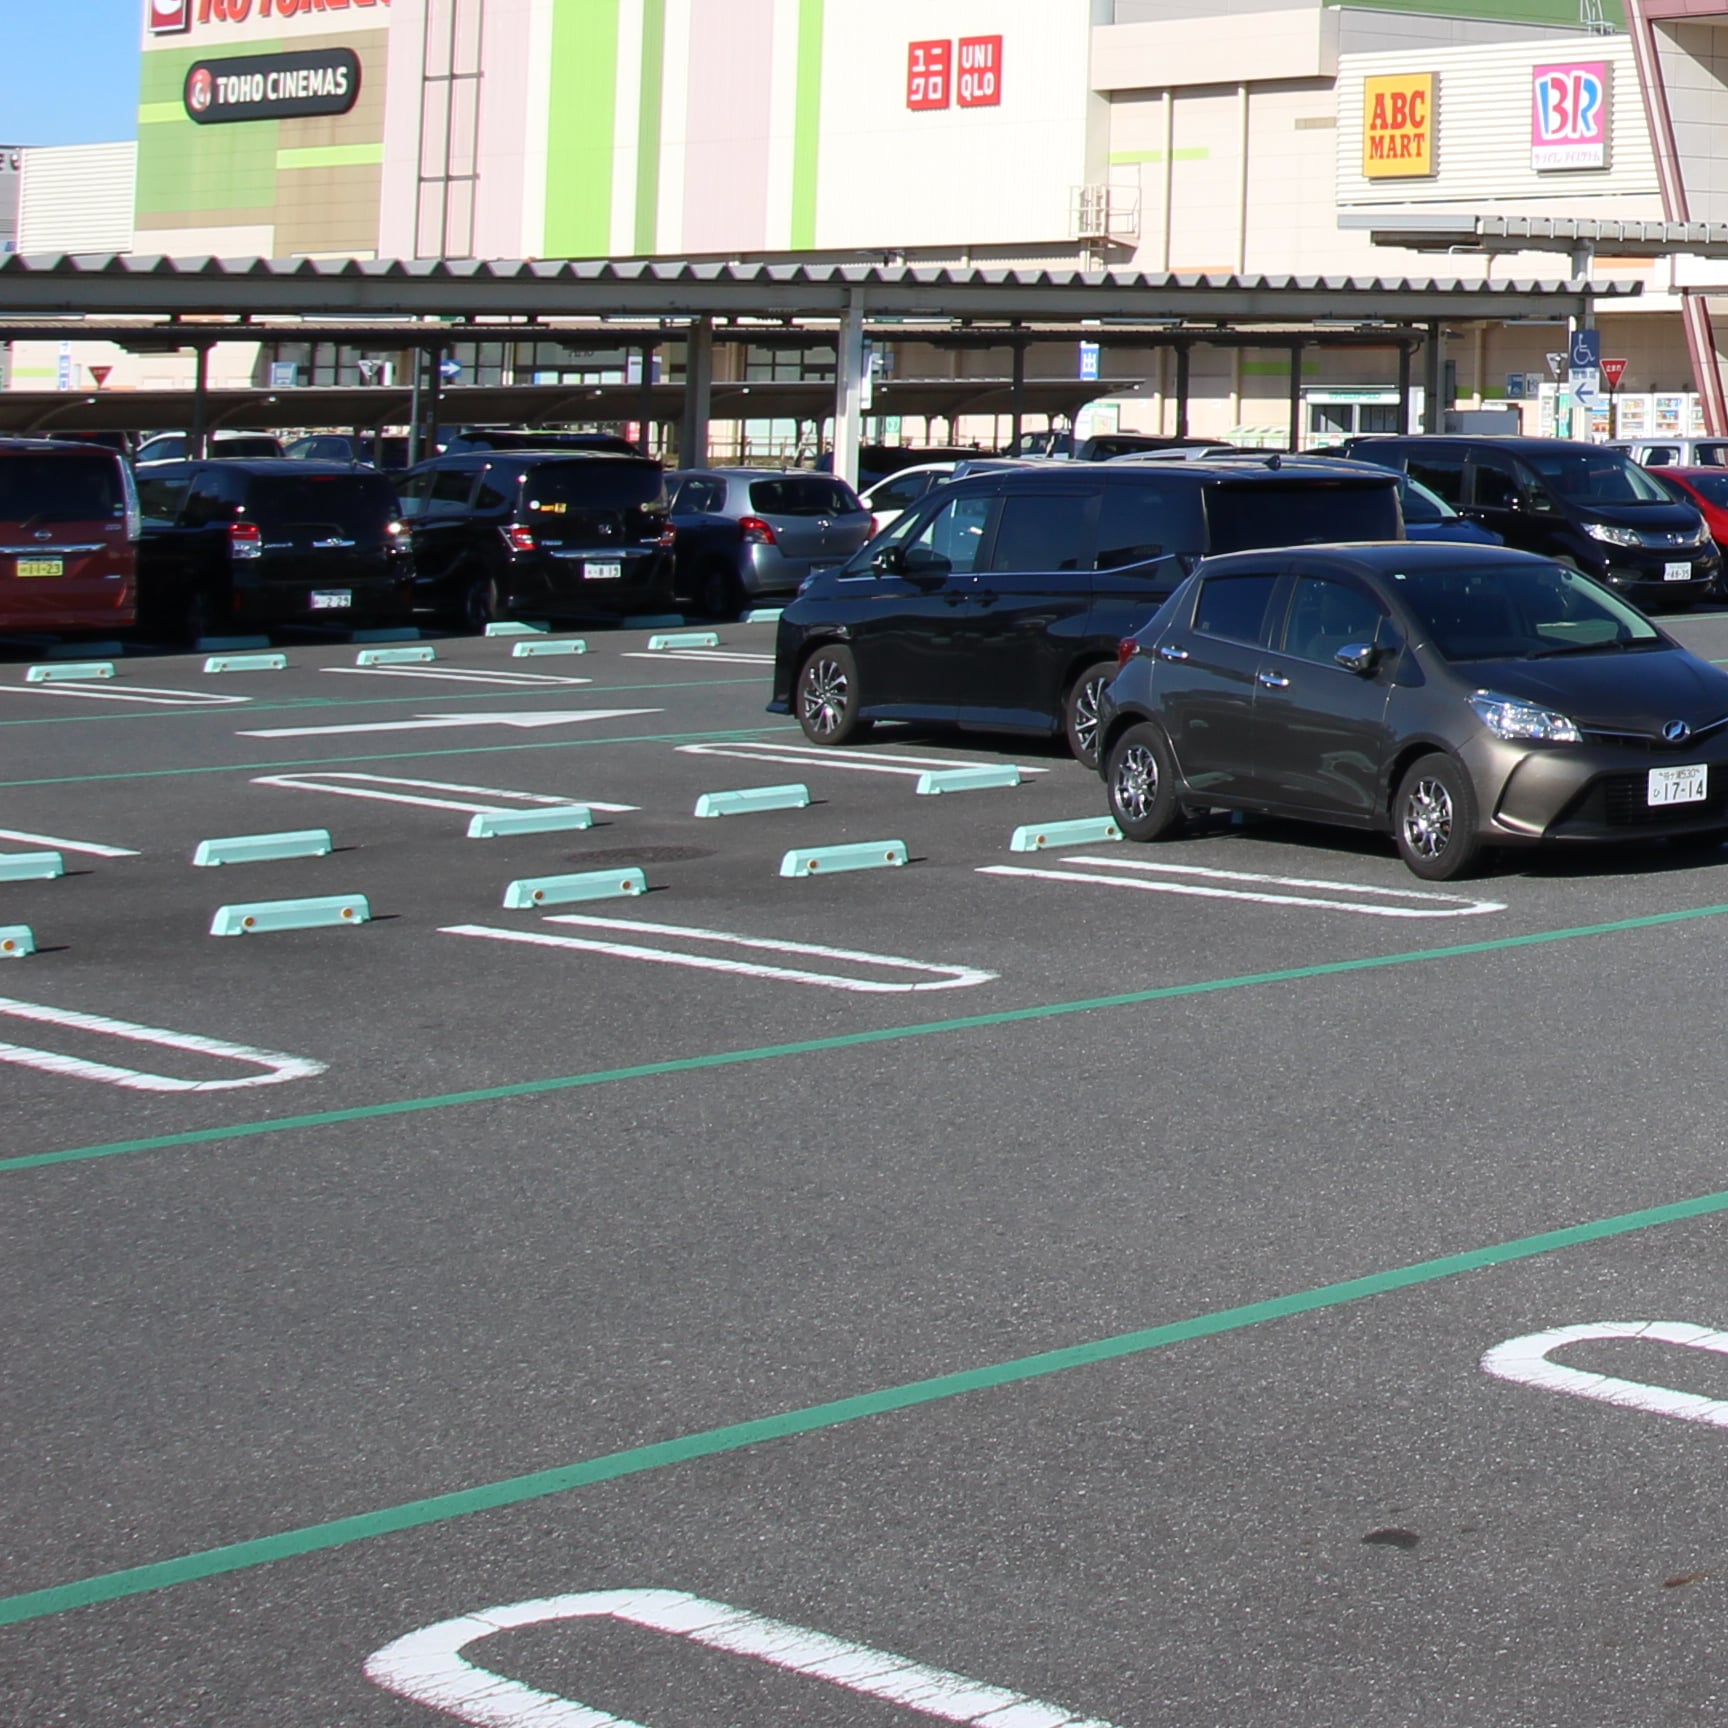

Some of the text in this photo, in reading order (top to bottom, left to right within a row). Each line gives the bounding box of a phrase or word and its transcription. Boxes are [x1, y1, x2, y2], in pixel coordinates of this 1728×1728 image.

[911, 47, 944, 73] ユニ
[961, 43, 994, 70] UNI
[216, 66, 349, 105] TOHO CINEMAS
[909, 75, 944, 102] クロ
[960, 71, 995, 102] QLO
[1369, 89, 1426, 131] ABC
[1368, 132, 1425, 160] MART
[1664, 779, 1704, 801] 17-14
